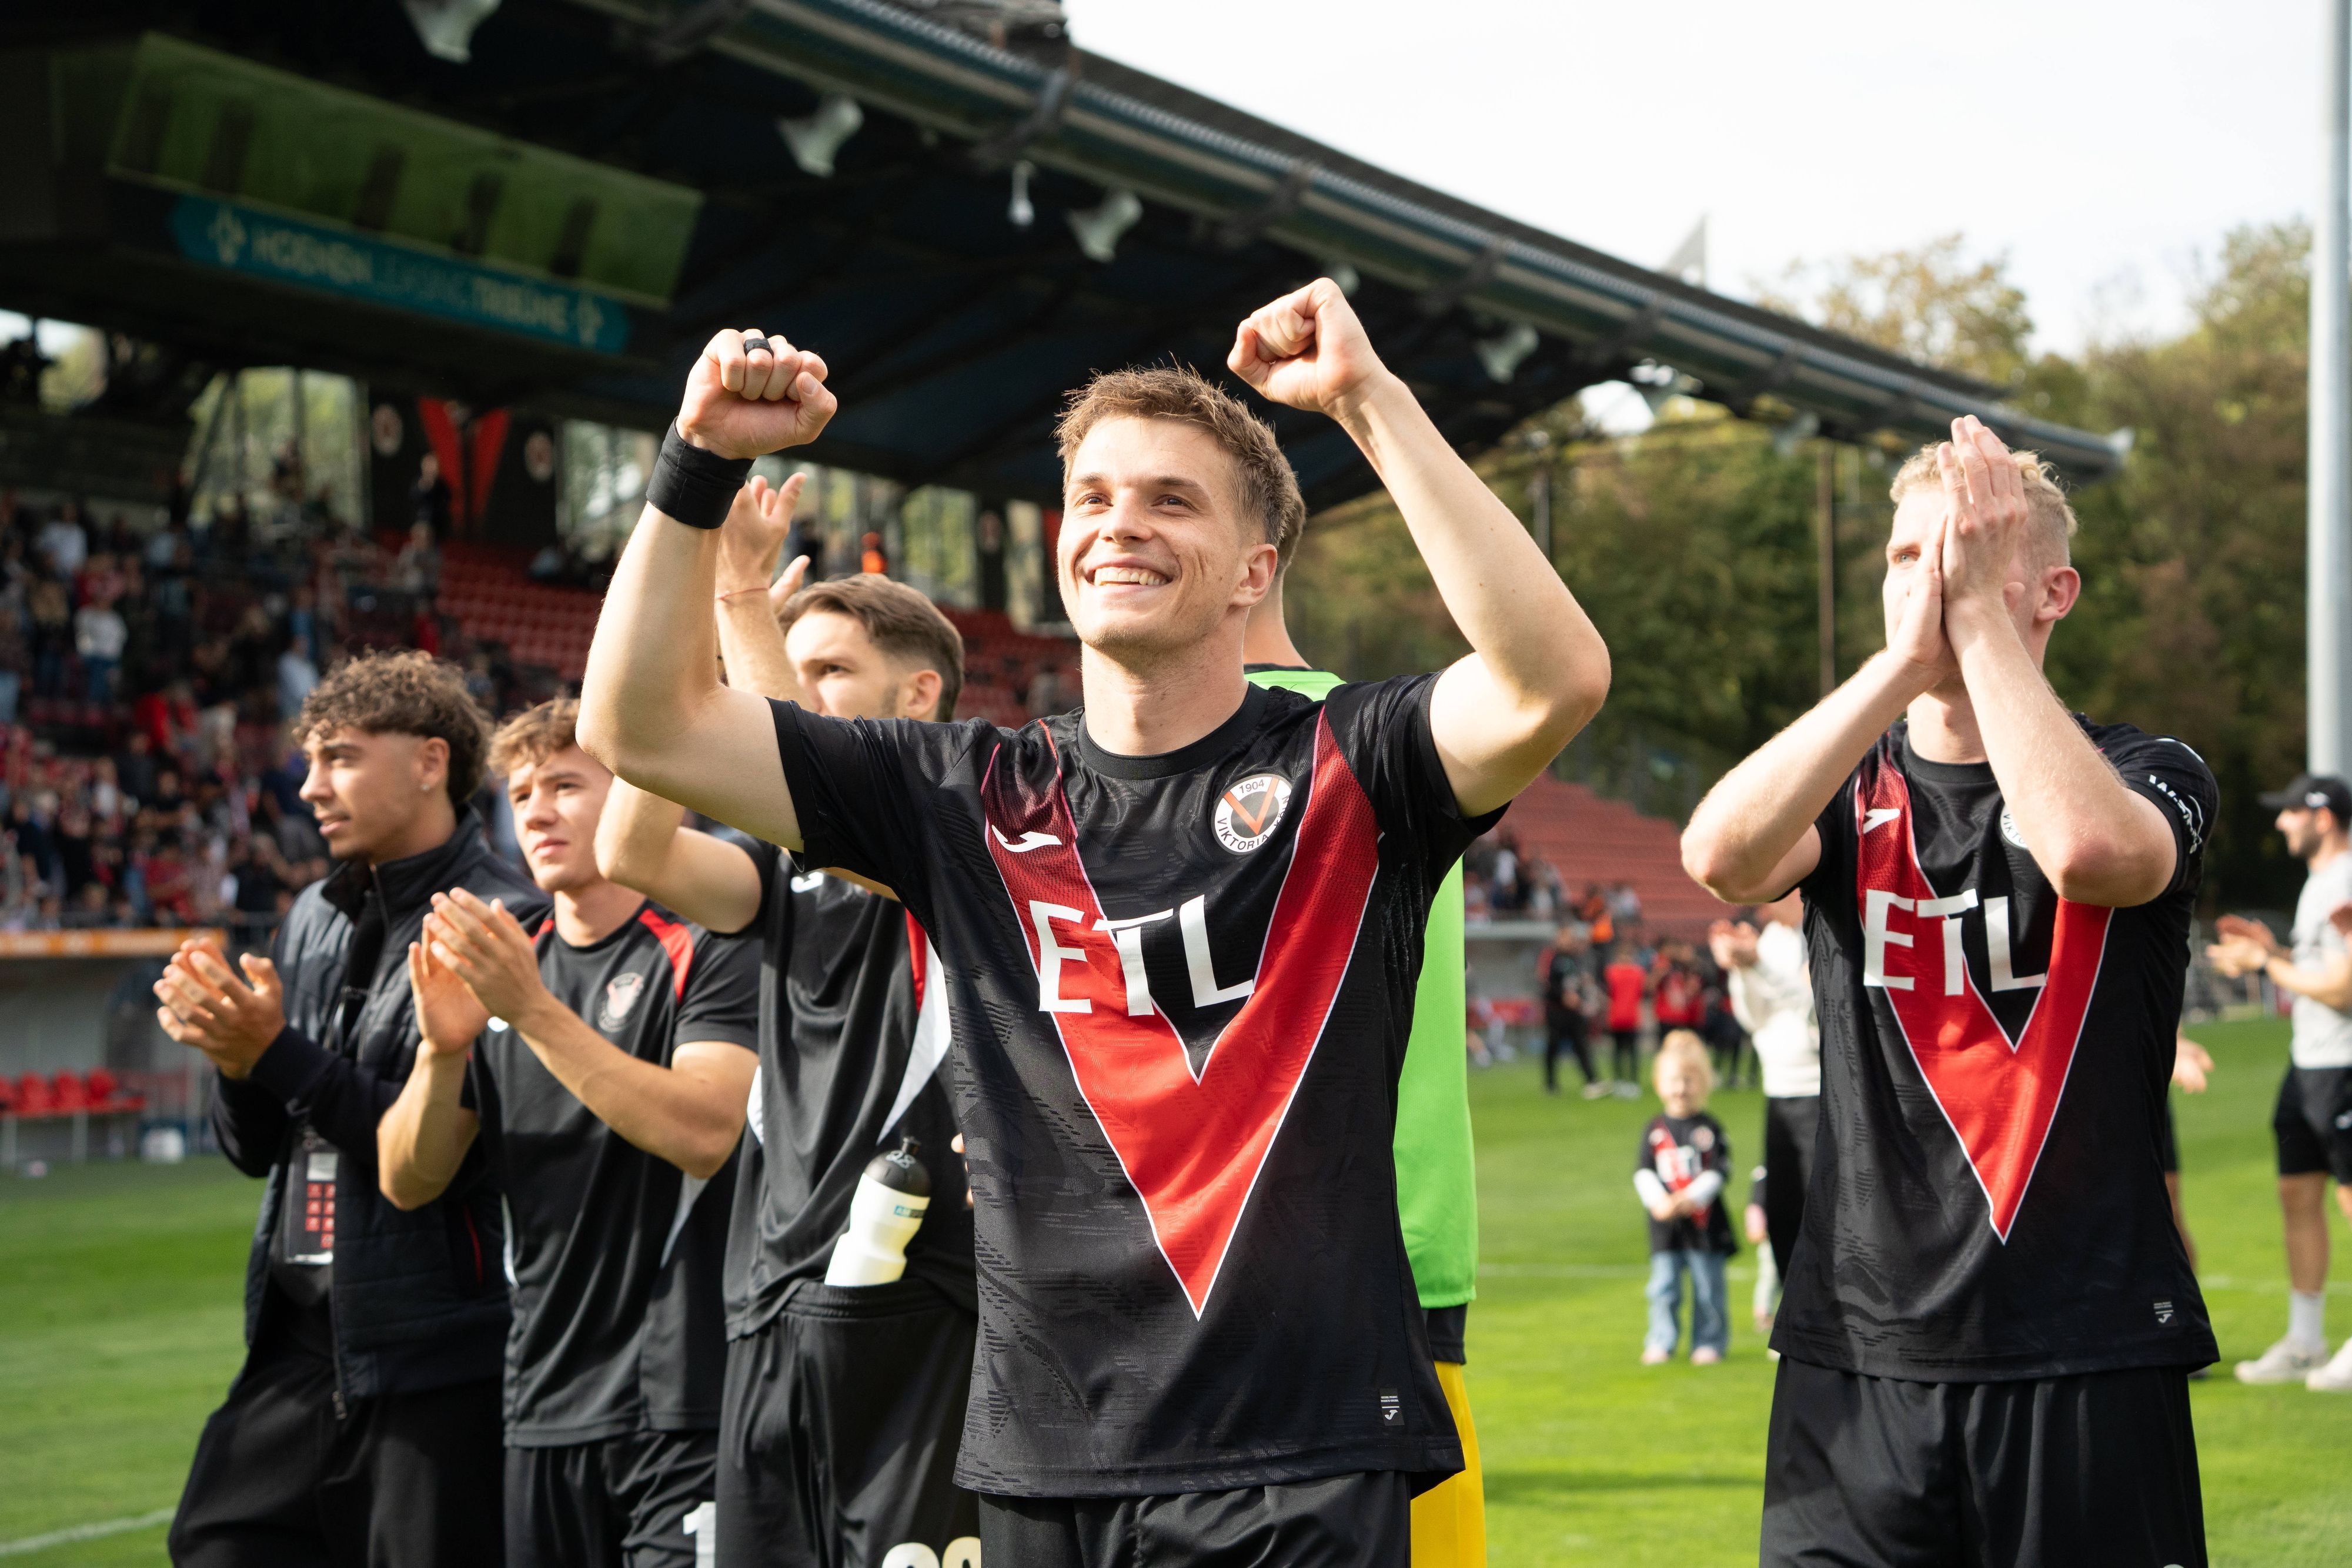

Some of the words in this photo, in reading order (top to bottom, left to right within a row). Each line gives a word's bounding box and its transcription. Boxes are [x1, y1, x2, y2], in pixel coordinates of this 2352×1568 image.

[1239, 779, 1265, 794] 1904
[1217, 817, 1268, 850] VIKTORIA
[1028, 894, 1255, 1016] ETL
[1863, 888, 2047, 996] ETL
